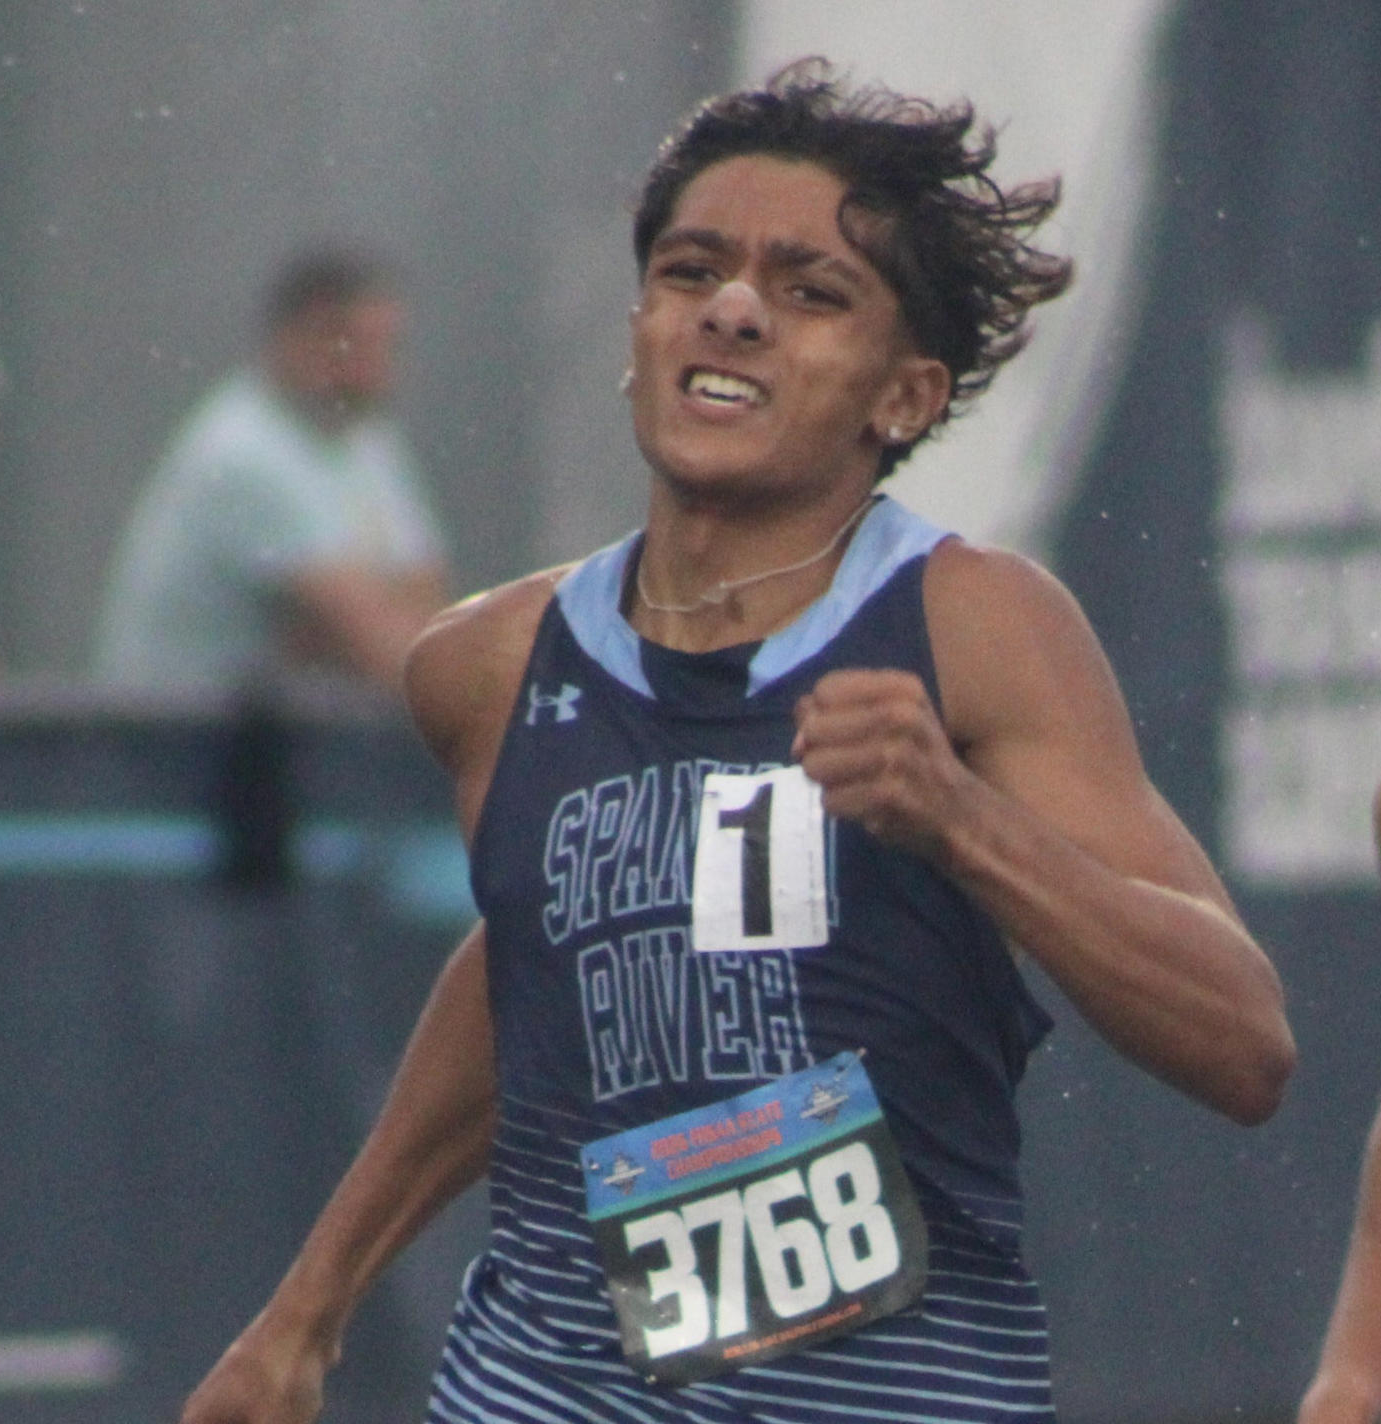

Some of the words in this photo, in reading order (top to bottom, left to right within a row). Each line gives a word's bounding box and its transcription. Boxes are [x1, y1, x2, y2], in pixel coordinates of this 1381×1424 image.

[543, 759, 840, 945] SPAN
[718, 781, 774, 938] 1
[577, 926, 817, 1103] RIVER
[623, 1141, 900, 1360] 3768
